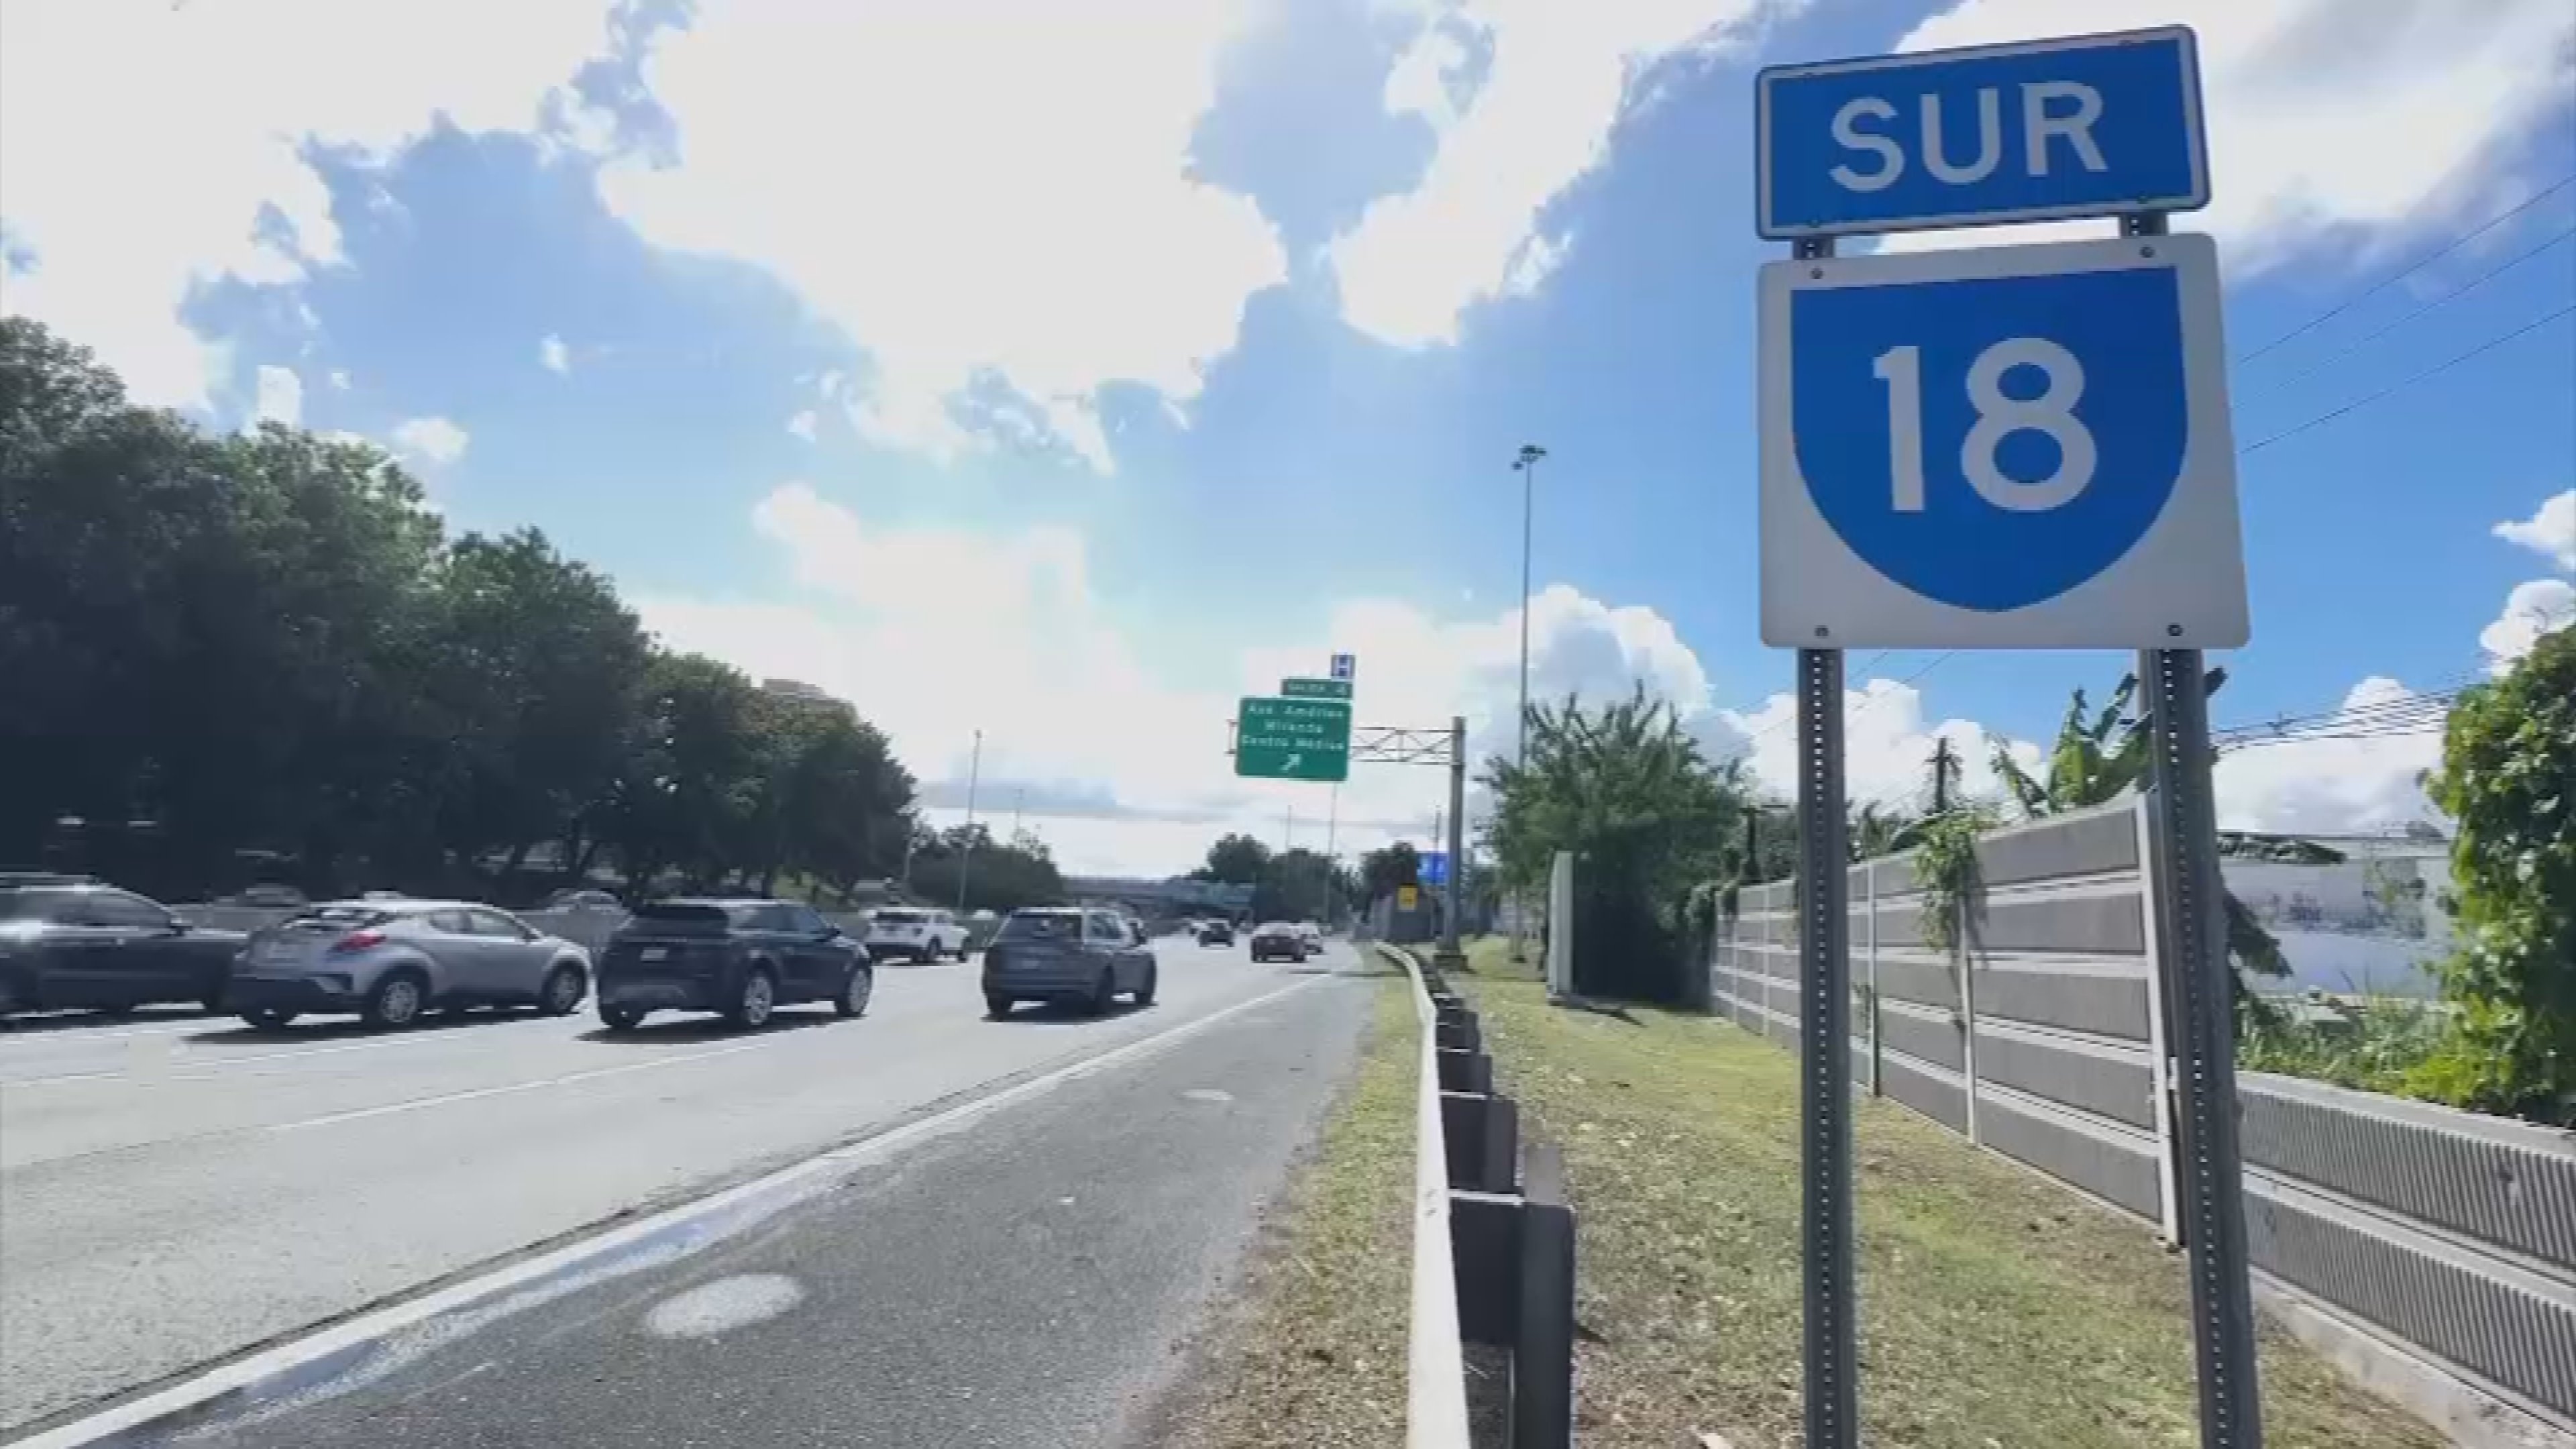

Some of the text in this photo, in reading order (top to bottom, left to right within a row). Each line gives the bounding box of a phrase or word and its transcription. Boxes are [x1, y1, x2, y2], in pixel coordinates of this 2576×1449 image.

[1829, 80, 2108, 193] SUR
[1874, 337, 2098, 512] 18
[1241, 735, 1289, 747] Centro
[1265, 719, 1324, 735] Miranda
